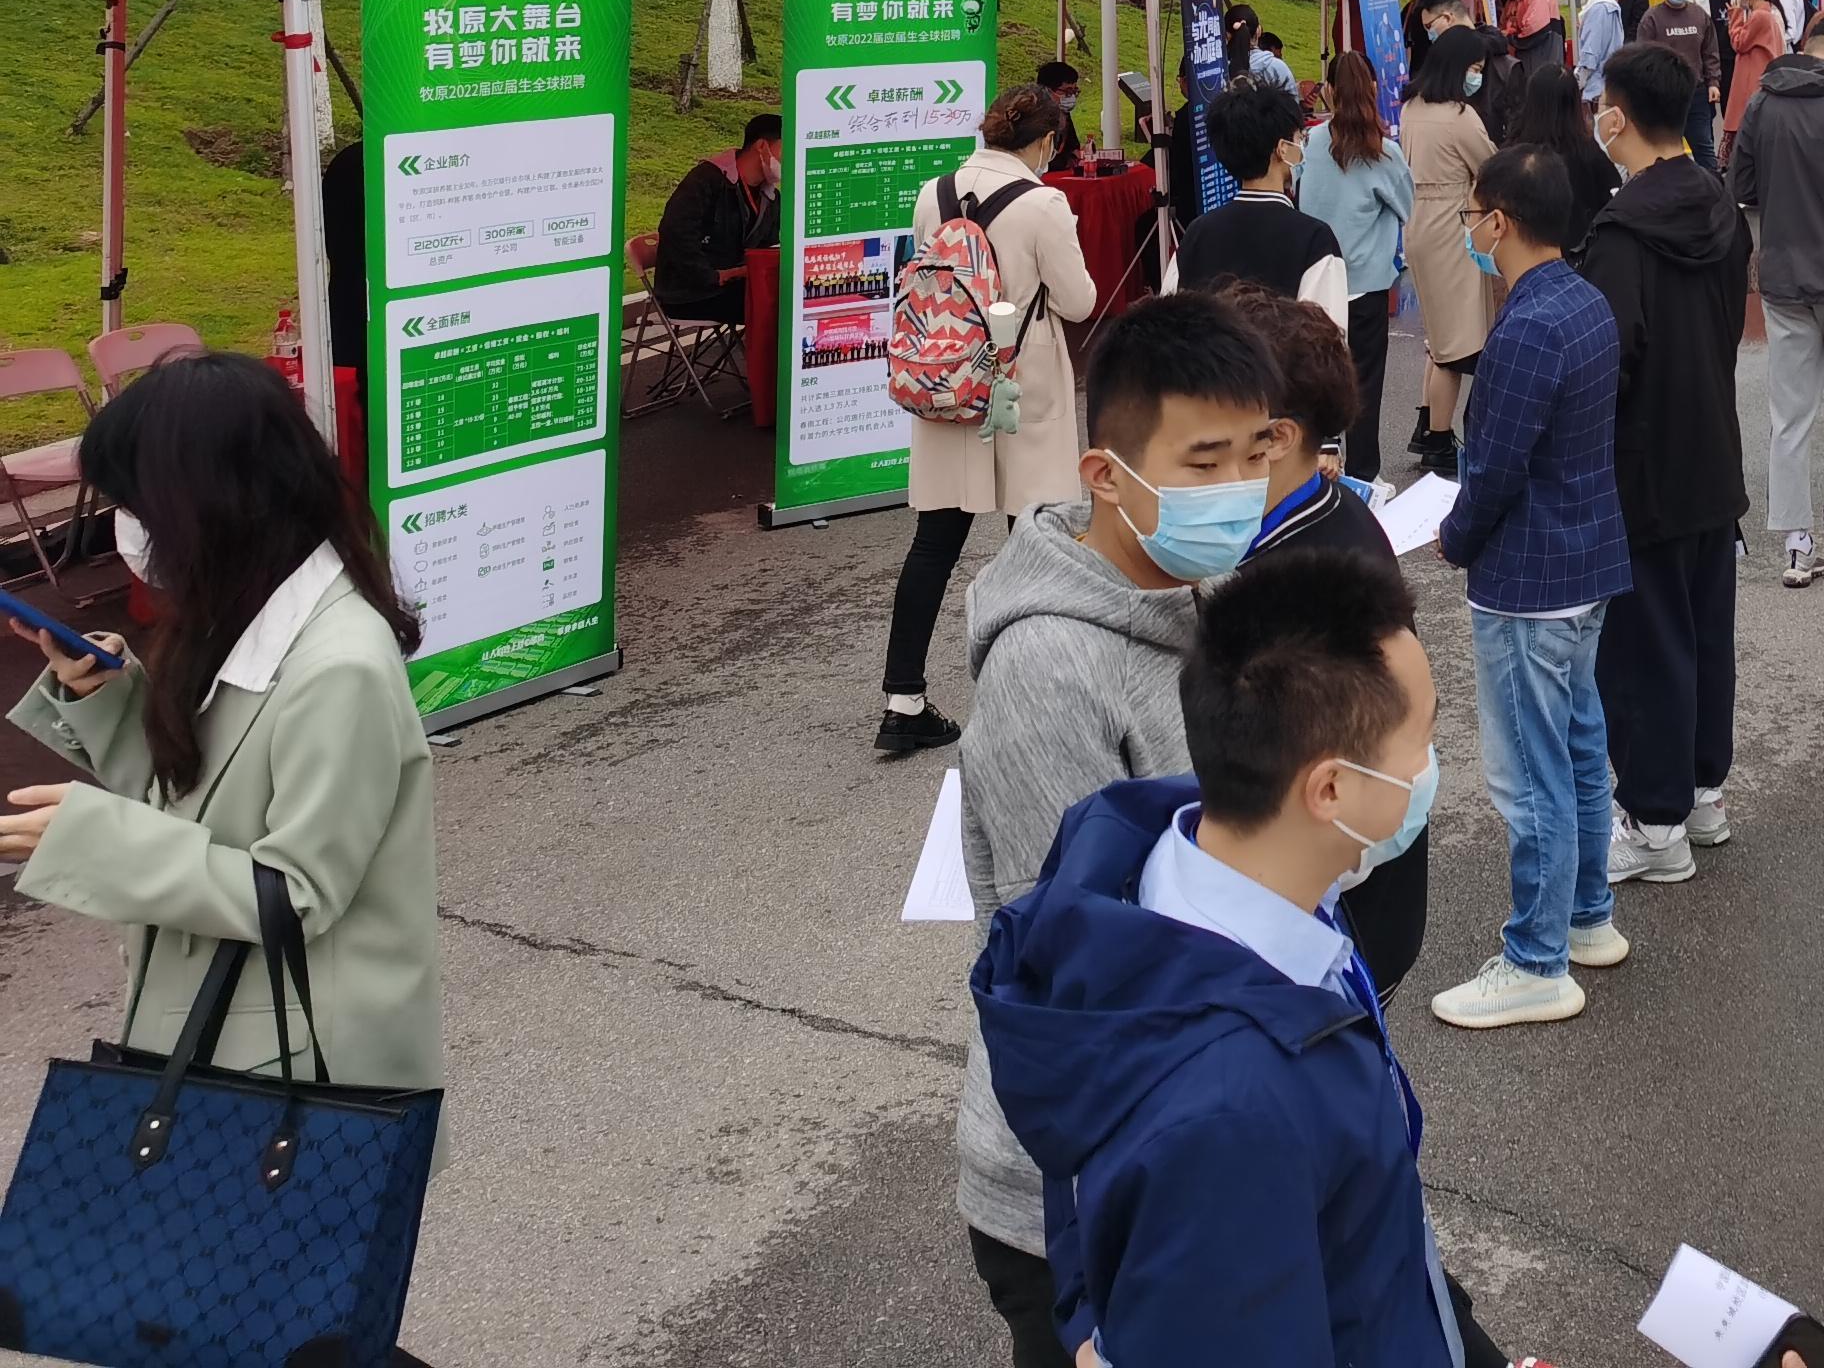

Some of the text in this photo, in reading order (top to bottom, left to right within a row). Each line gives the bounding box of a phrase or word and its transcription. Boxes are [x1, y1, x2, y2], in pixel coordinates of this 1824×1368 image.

[423, 2, 581, 36] 牧原大舞台
[830, 0, 954, 22] 有梦你就来
[825, 29, 961, 47] 牧原2022届应届生全球招聘
[423, 35, 581, 71] 有梦你就来
[420, 74, 585, 103] 牧原2022届应届生全球招聘
[866, 88, 924, 104] 卓越薪酬
[424, 153, 471, 172] 企业简介
[426, 311, 471, 331] 全面薪酬
[424, 504, 468, 527] 招聘大类
